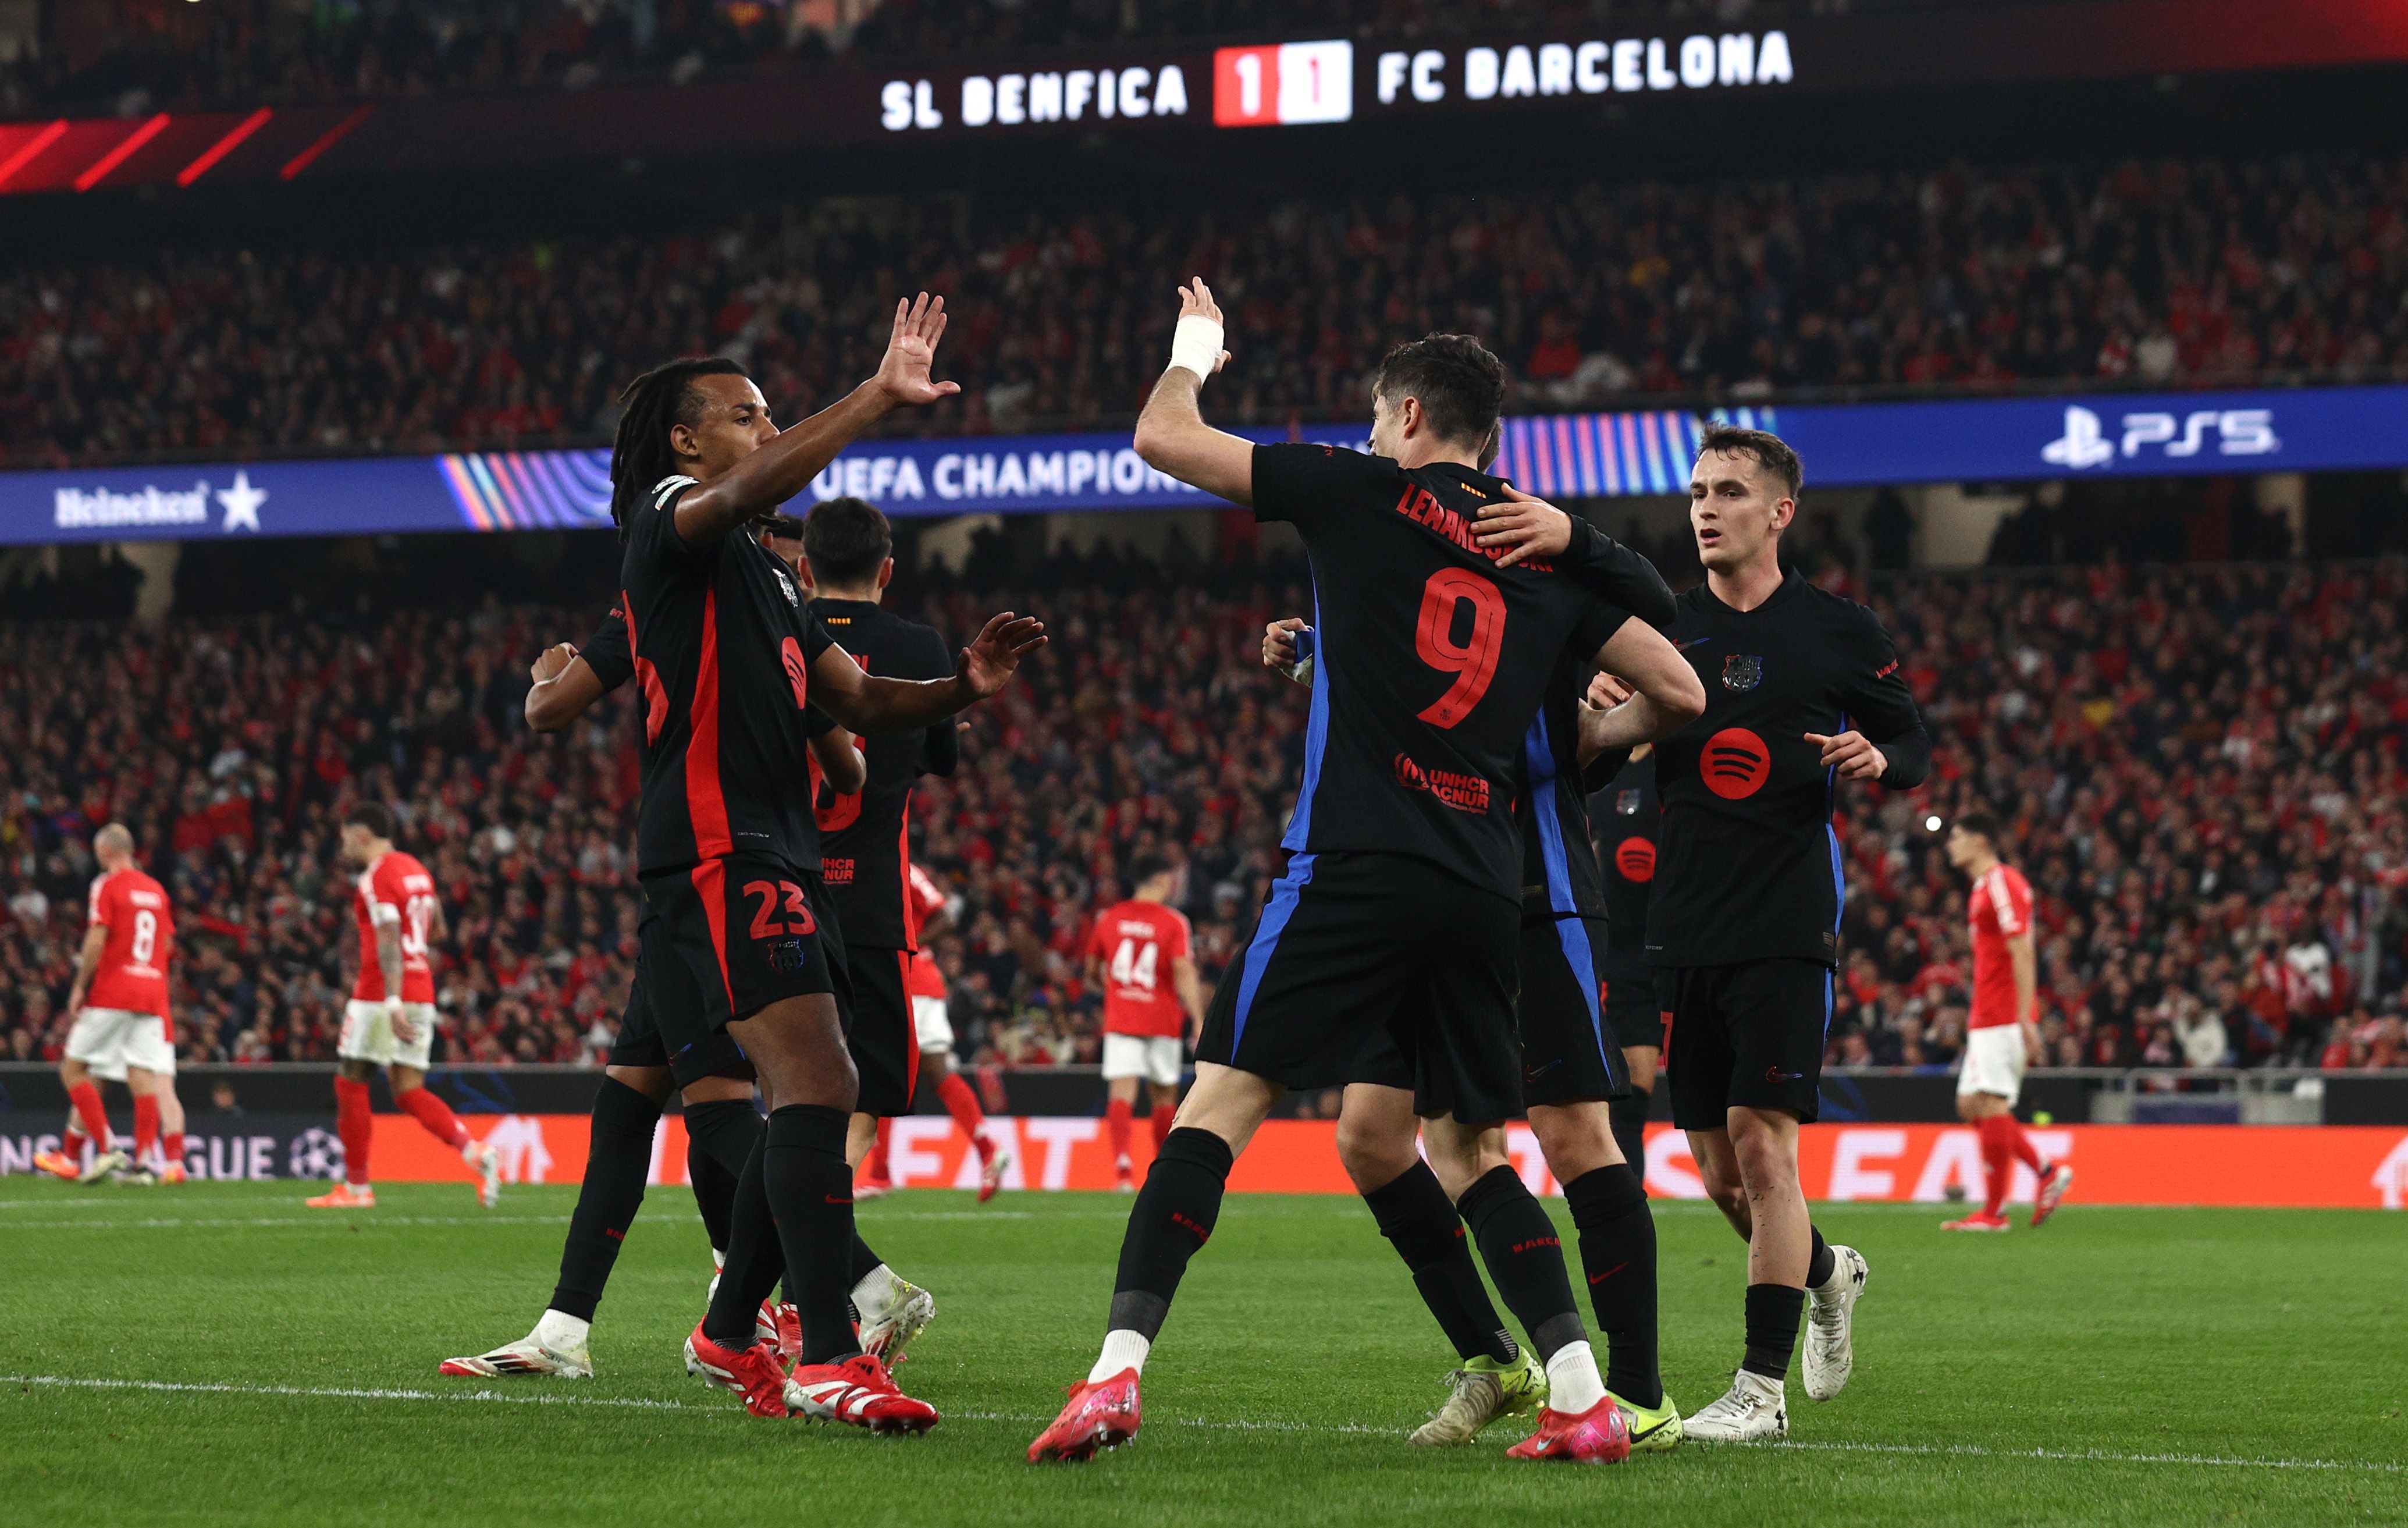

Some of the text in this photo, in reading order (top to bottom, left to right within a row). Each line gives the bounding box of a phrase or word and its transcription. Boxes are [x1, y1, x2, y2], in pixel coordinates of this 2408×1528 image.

[881, 80, 943, 130] SL
[961, 65, 1188, 127] BENFICA
[1234, 53, 1262, 117] 1
[1377, 50, 1445, 104] FC
[1464, 31, 1793, 100] BARCELONA
[2121, 408, 2275, 458] PS5
[810, 447, 1201, 502] UEFA CHAMPIO
[1415, 567, 1507, 730] 9
[1429, 769, 1489, 794] UNHCR
[131, 909, 158, 964] 8
[742, 879, 817, 940] 23
[1111, 937, 1158, 990] 44
